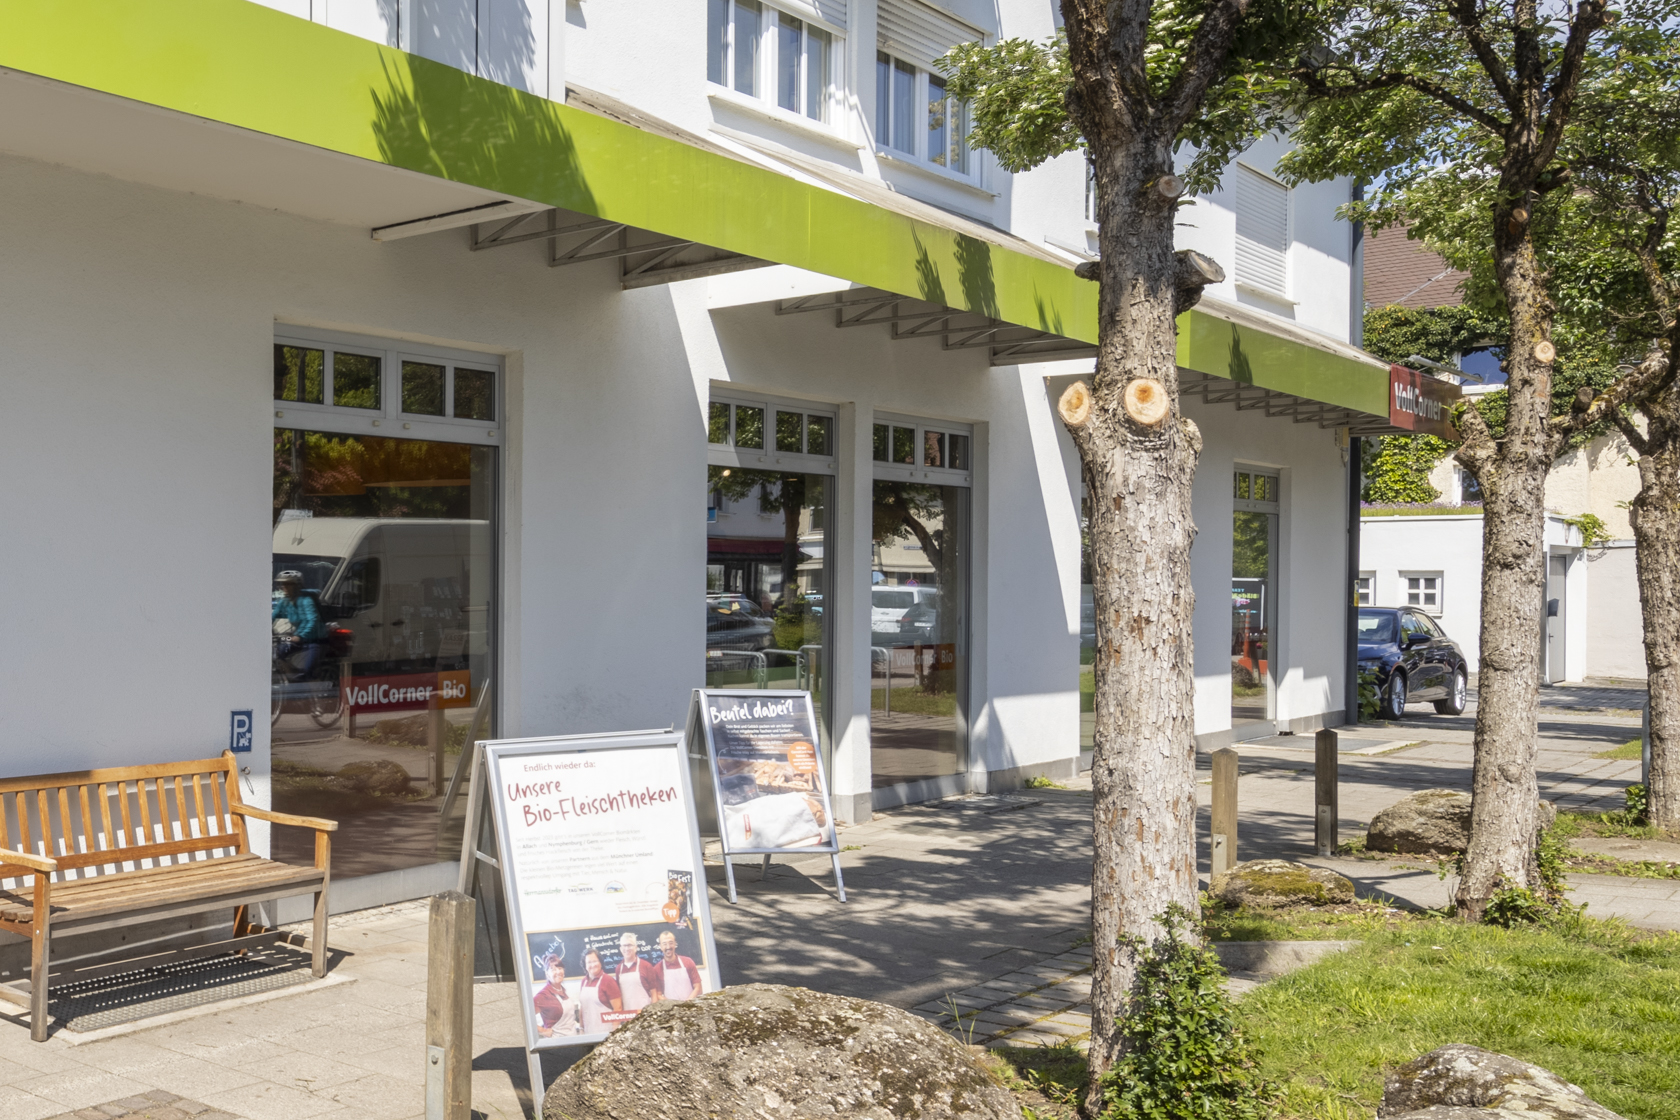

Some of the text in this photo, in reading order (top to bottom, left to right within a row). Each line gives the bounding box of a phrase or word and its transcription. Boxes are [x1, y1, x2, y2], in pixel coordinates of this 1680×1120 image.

[1394, 381, 1442, 420] VollCorner
[896, 650, 953, 666] VollCorner Bio
[346, 679, 466, 706] VollCorner Bio
[709, 699, 794, 724] Beutel dabei?
[233, 715, 249, 747] P
[524, 760, 596, 772] Endlich wieder da:
[507, 780, 562, 802] Unsere
[523, 786, 678, 827] Bio-Fleischtheken
[548, 839, 582, 848] Nymphenburg
[678, 874, 691, 883] Fest
